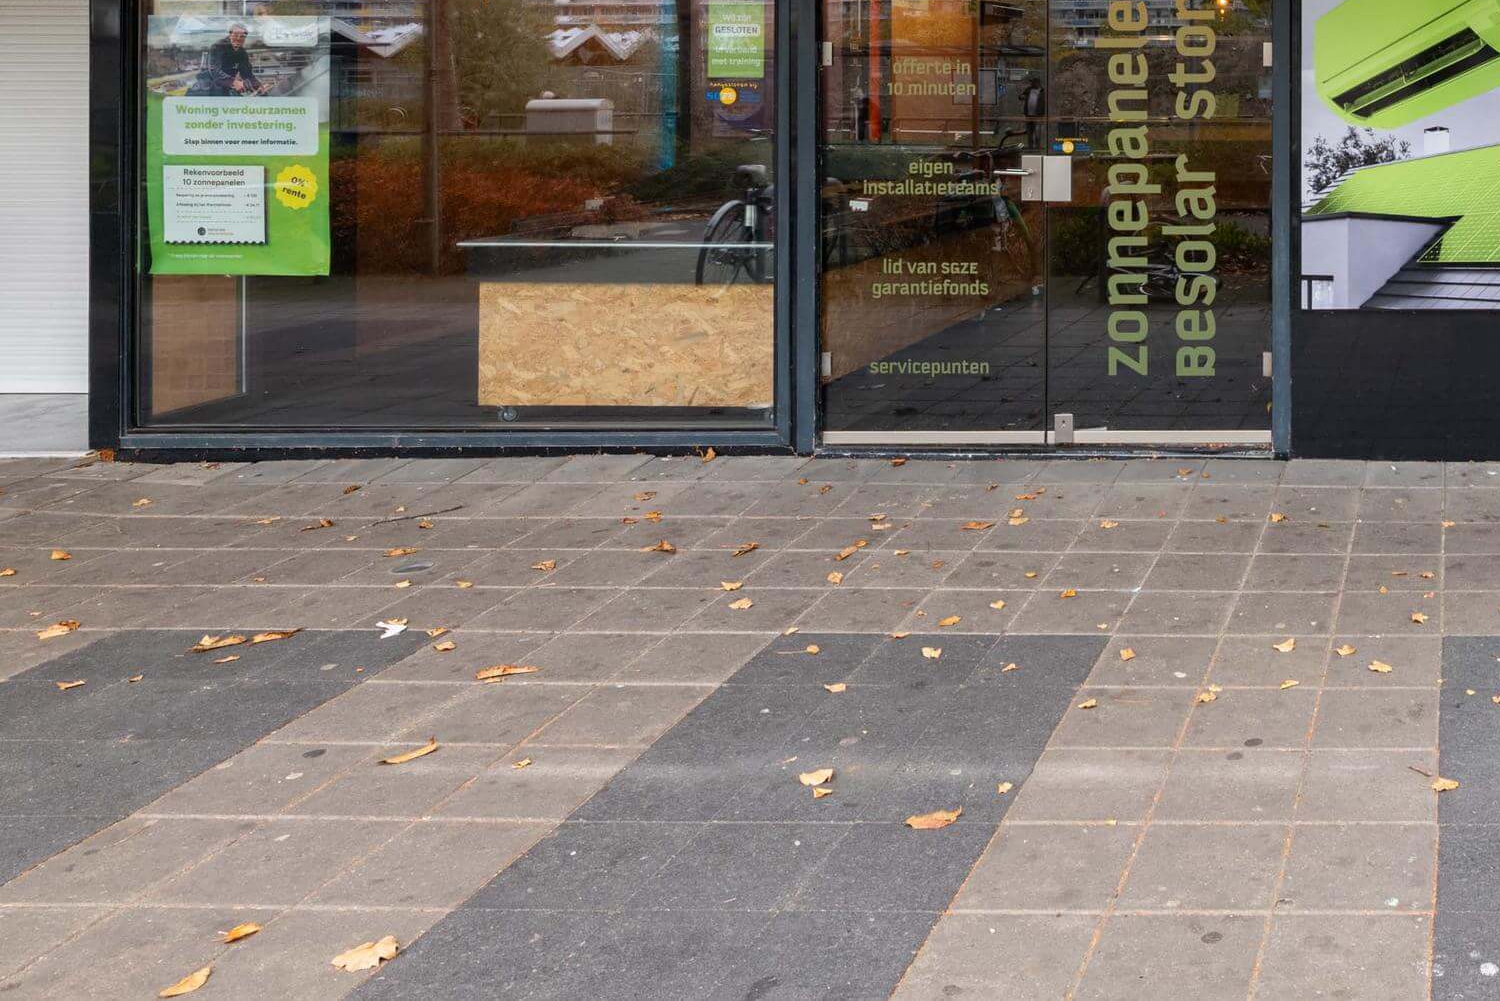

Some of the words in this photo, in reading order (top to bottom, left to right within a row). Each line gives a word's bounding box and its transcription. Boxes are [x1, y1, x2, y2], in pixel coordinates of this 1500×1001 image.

[714, 25, 759, 34] GESLOTEN
[892, 58, 950, 76] offerte
[955, 58, 972, 76] in
[887, 82, 903, 96] 10
[907, 81, 976, 97] minuten
[175, 103, 220, 117] Woning
[222, 103, 307, 116] verduurzamen
[184, 119, 224, 130] zonder
[226, 119, 297, 132] investering.
[183, 167, 245, 177] Rekenvoorbeeld
[908, 158, 954, 177] eigen
[182, 178, 192, 186] 10
[193, 178, 246, 187] zonnepanelen
[862, 179, 1000, 196] installatieteams
[281, 186, 307, 200] rente
[882, 258, 902, 275] lid
[907, 261, 937, 275] van
[941, 261, 979, 275] SGZE
[871, 279, 990, 299] garantiefonds
[869, 358, 990, 378] servicepunten
